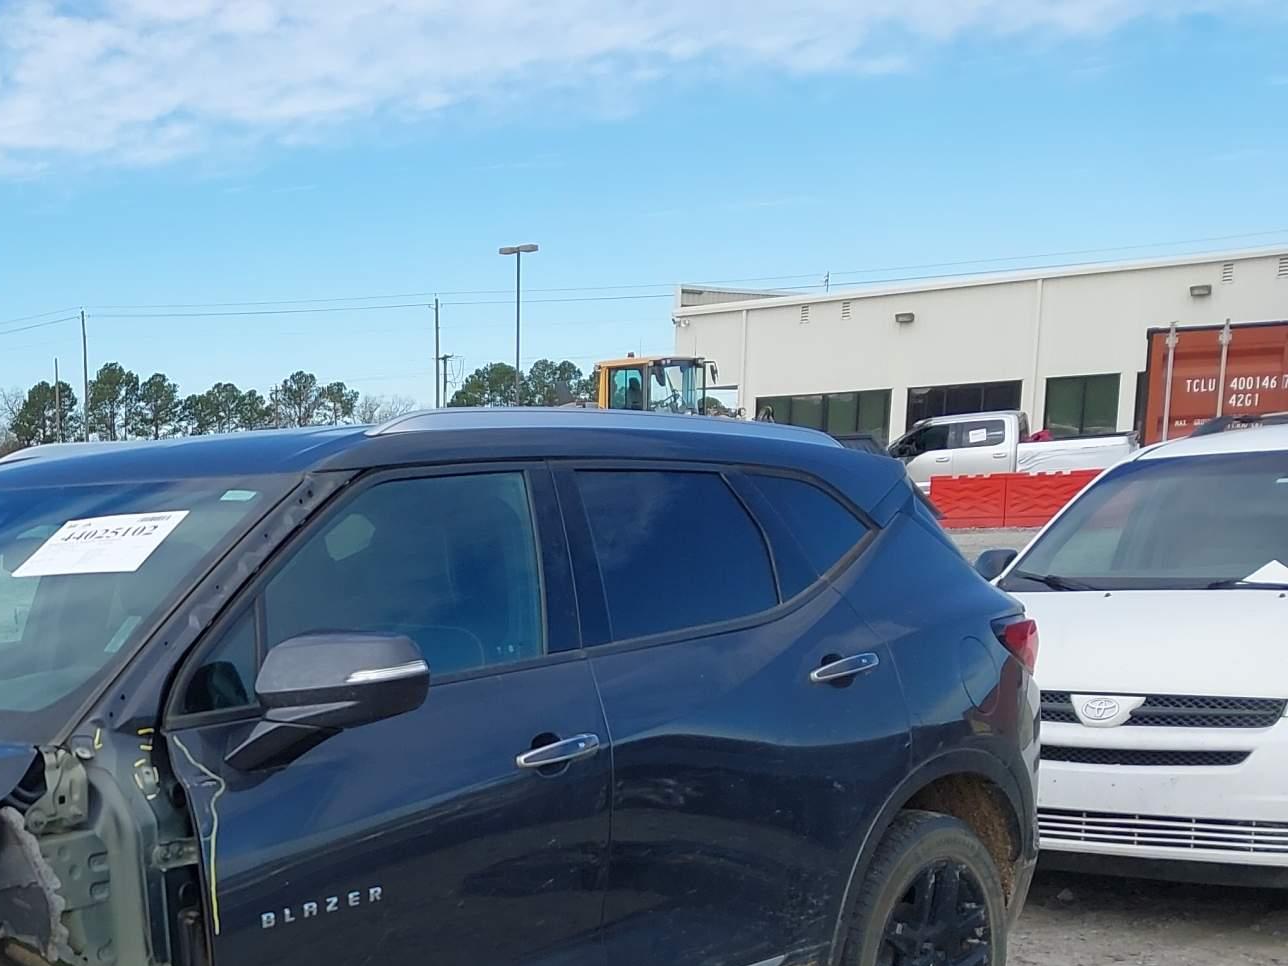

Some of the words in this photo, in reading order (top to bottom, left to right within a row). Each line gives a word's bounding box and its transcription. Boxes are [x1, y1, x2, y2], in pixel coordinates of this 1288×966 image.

[1186, 379, 1216, 392] TCLU
[1230, 376, 1278, 391] 400146
[1228, 394, 1260, 407] 42G1
[61, 525, 159, 542] 44025102
[261, 886, 382, 929] BLAZER
